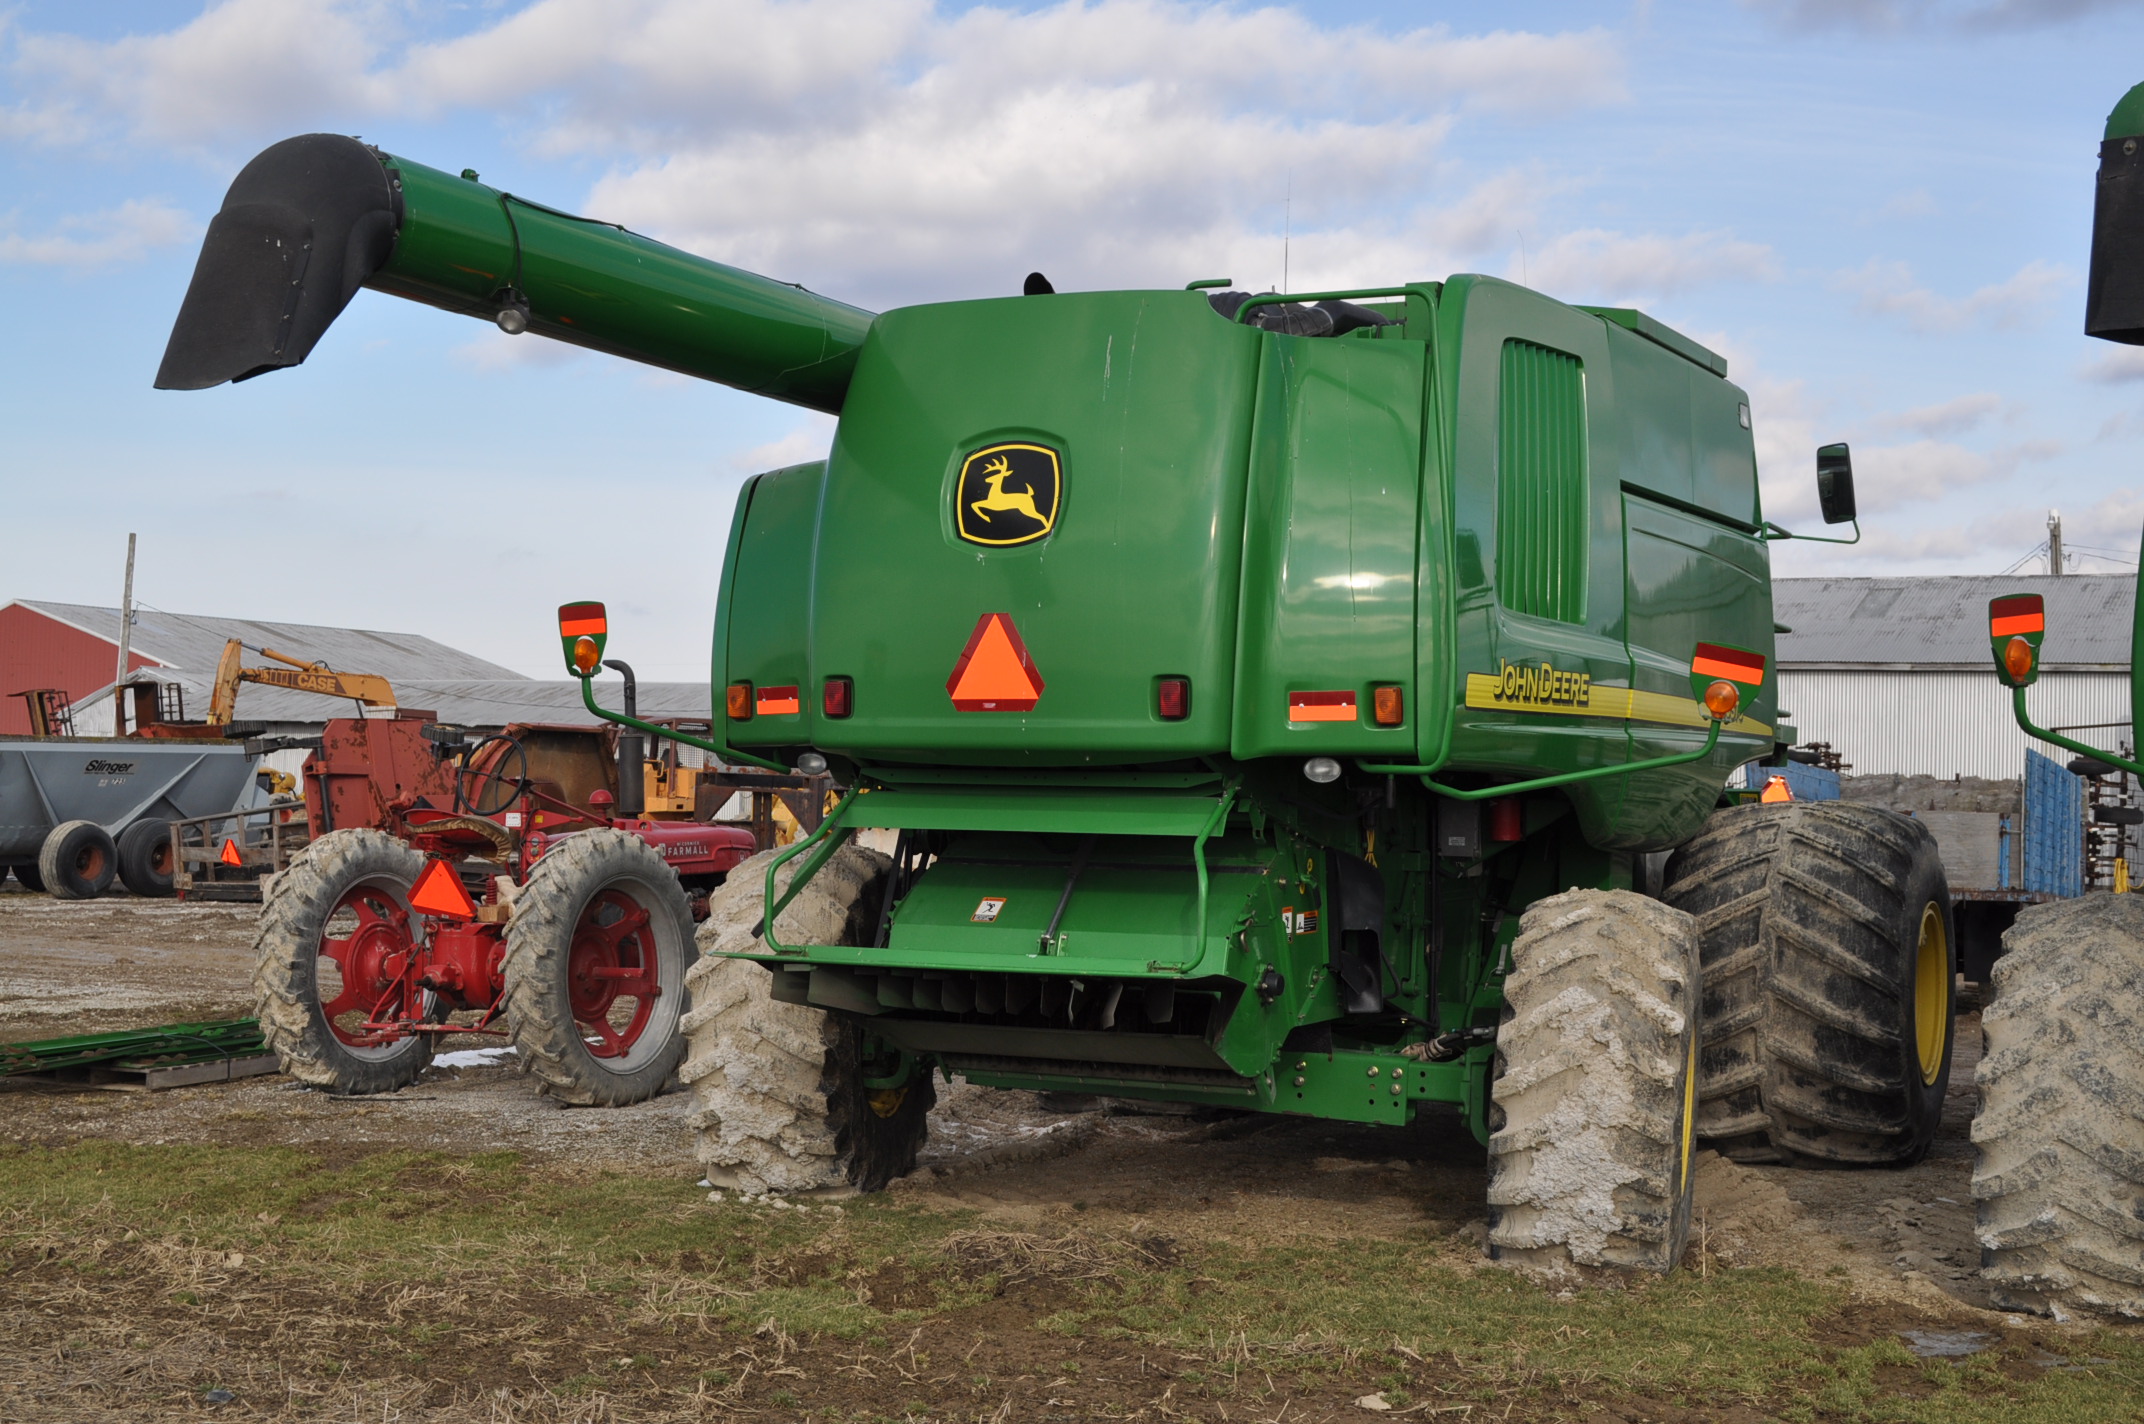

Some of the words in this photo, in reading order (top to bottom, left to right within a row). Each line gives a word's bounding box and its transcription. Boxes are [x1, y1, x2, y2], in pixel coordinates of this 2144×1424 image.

[297, 674, 337, 692] CASE
[1493, 656, 1540, 703] JOHN
[1539, 661, 1590, 707] DEERE
[85, 759, 134, 775] Slinger
[667, 845, 709, 856] FARMALL
